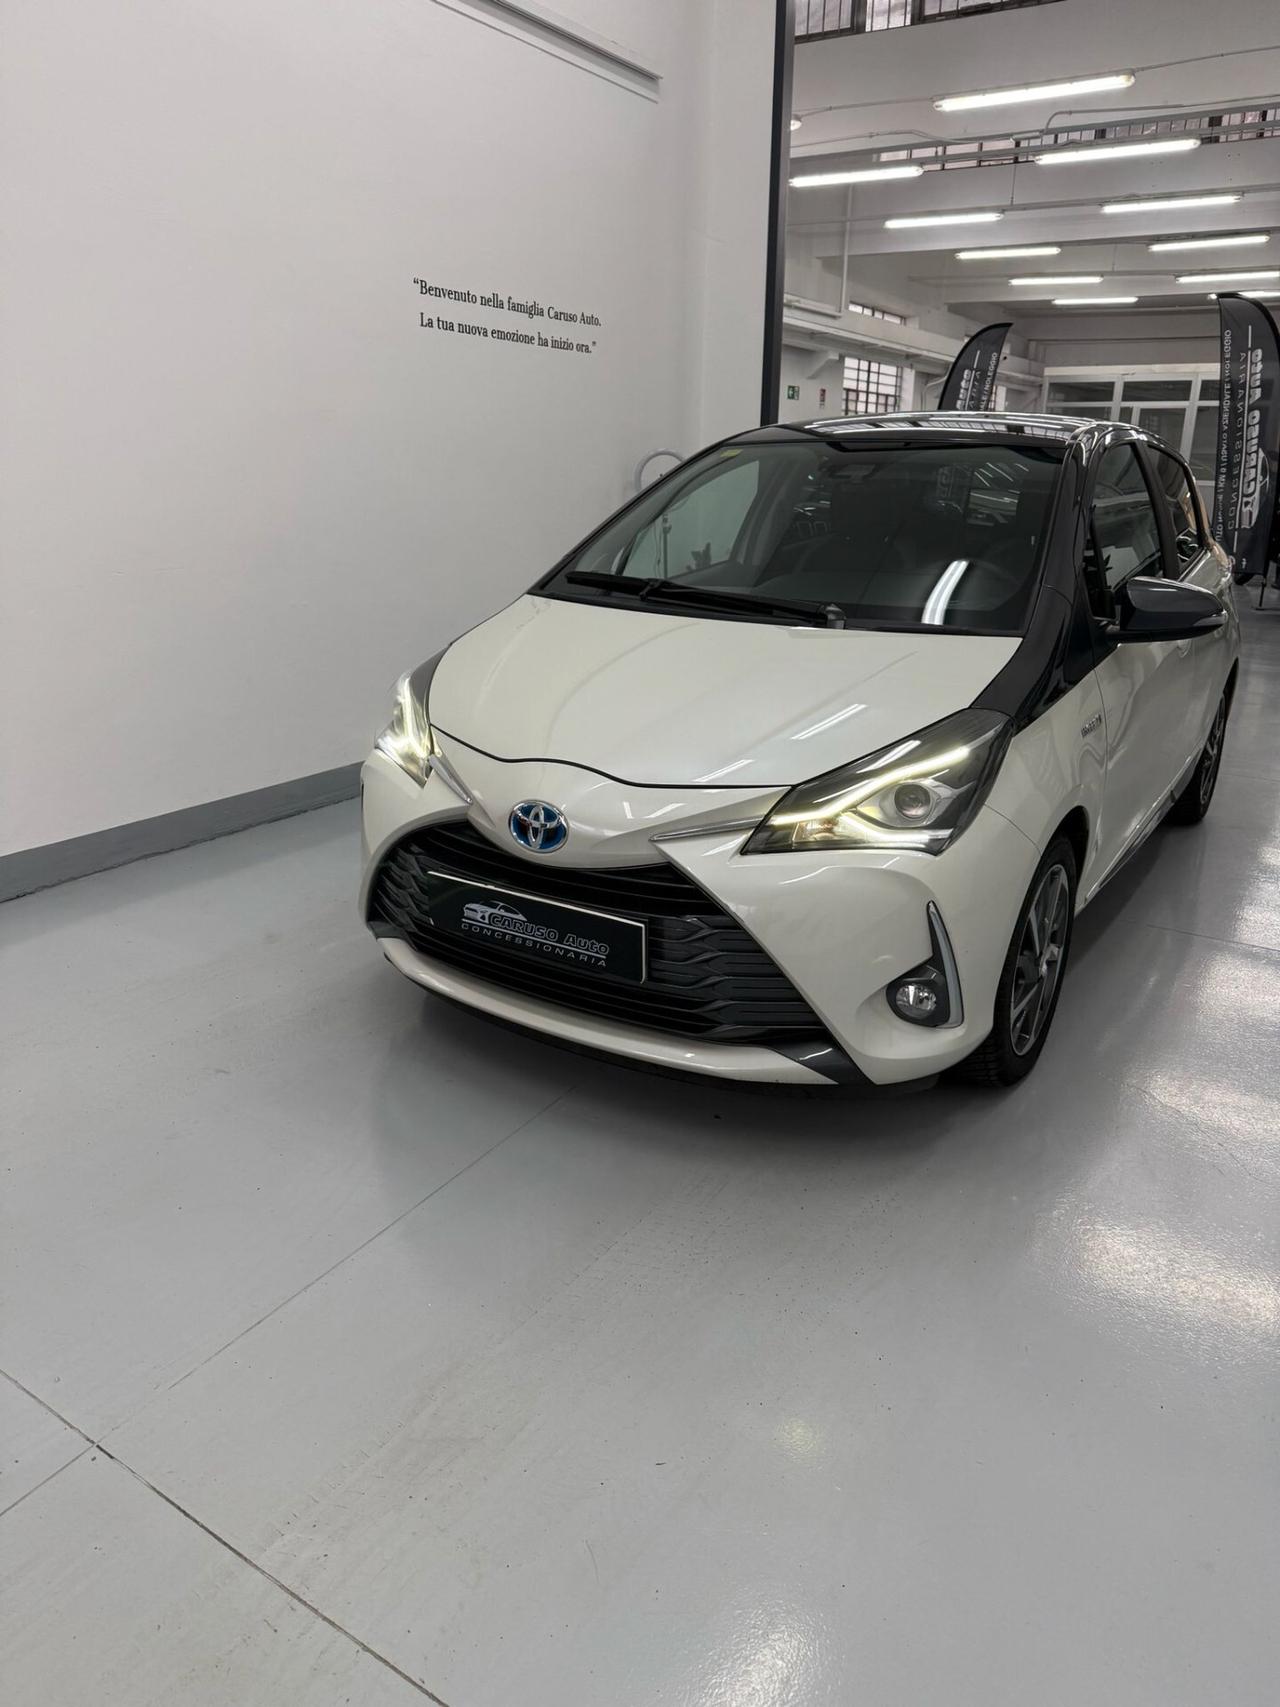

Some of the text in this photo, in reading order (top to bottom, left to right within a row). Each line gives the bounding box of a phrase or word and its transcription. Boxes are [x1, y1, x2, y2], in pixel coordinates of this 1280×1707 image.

[480, 293, 504, 309] nella
[507, 296, 544, 319] famiglia
[547, 306, 577, 323] Caruso
[579, 312, 602, 327] Auto.
[420, 312, 434, 328] La
[437, 316, 455, 332] tua
[458, 321, 489, 338] nuova
[490, 328, 535, 345] emozione
[538, 332, 549, 347] ha
[550, 335, 574, 351] inizio
[984, 352, 998, 389] NOLEGGIO
[461, 923, 607, 967] CONCESSIONARIA
[490, 914, 559, 942] CARUSO
